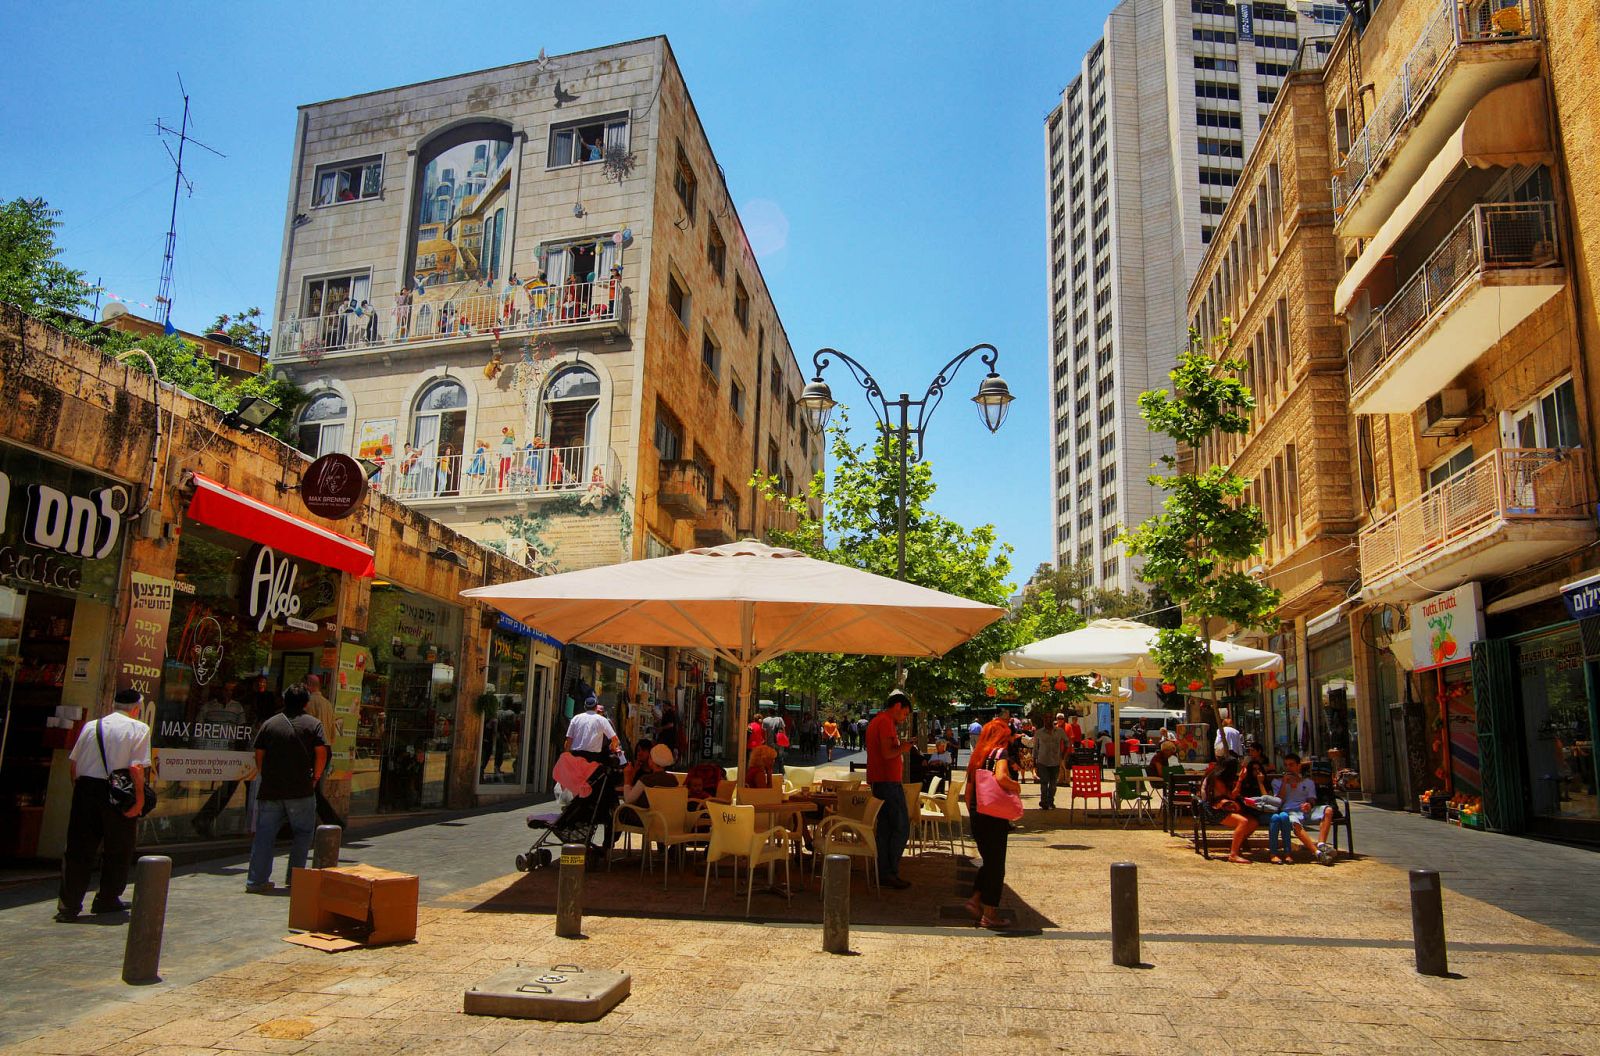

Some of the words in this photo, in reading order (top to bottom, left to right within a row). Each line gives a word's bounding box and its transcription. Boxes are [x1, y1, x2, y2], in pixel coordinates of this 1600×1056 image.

[35, 486, 120, 560] לחם
[250, 545, 300, 633] Aldo
[135, 619, 162, 635] קפה
[135, 633, 158, 650] XXL
[122, 663, 161, 679] מאפה
[130, 679, 151, 694] XXL
[161, 720, 191, 737] MAX
[194, 723, 252, 740] BRENNER
